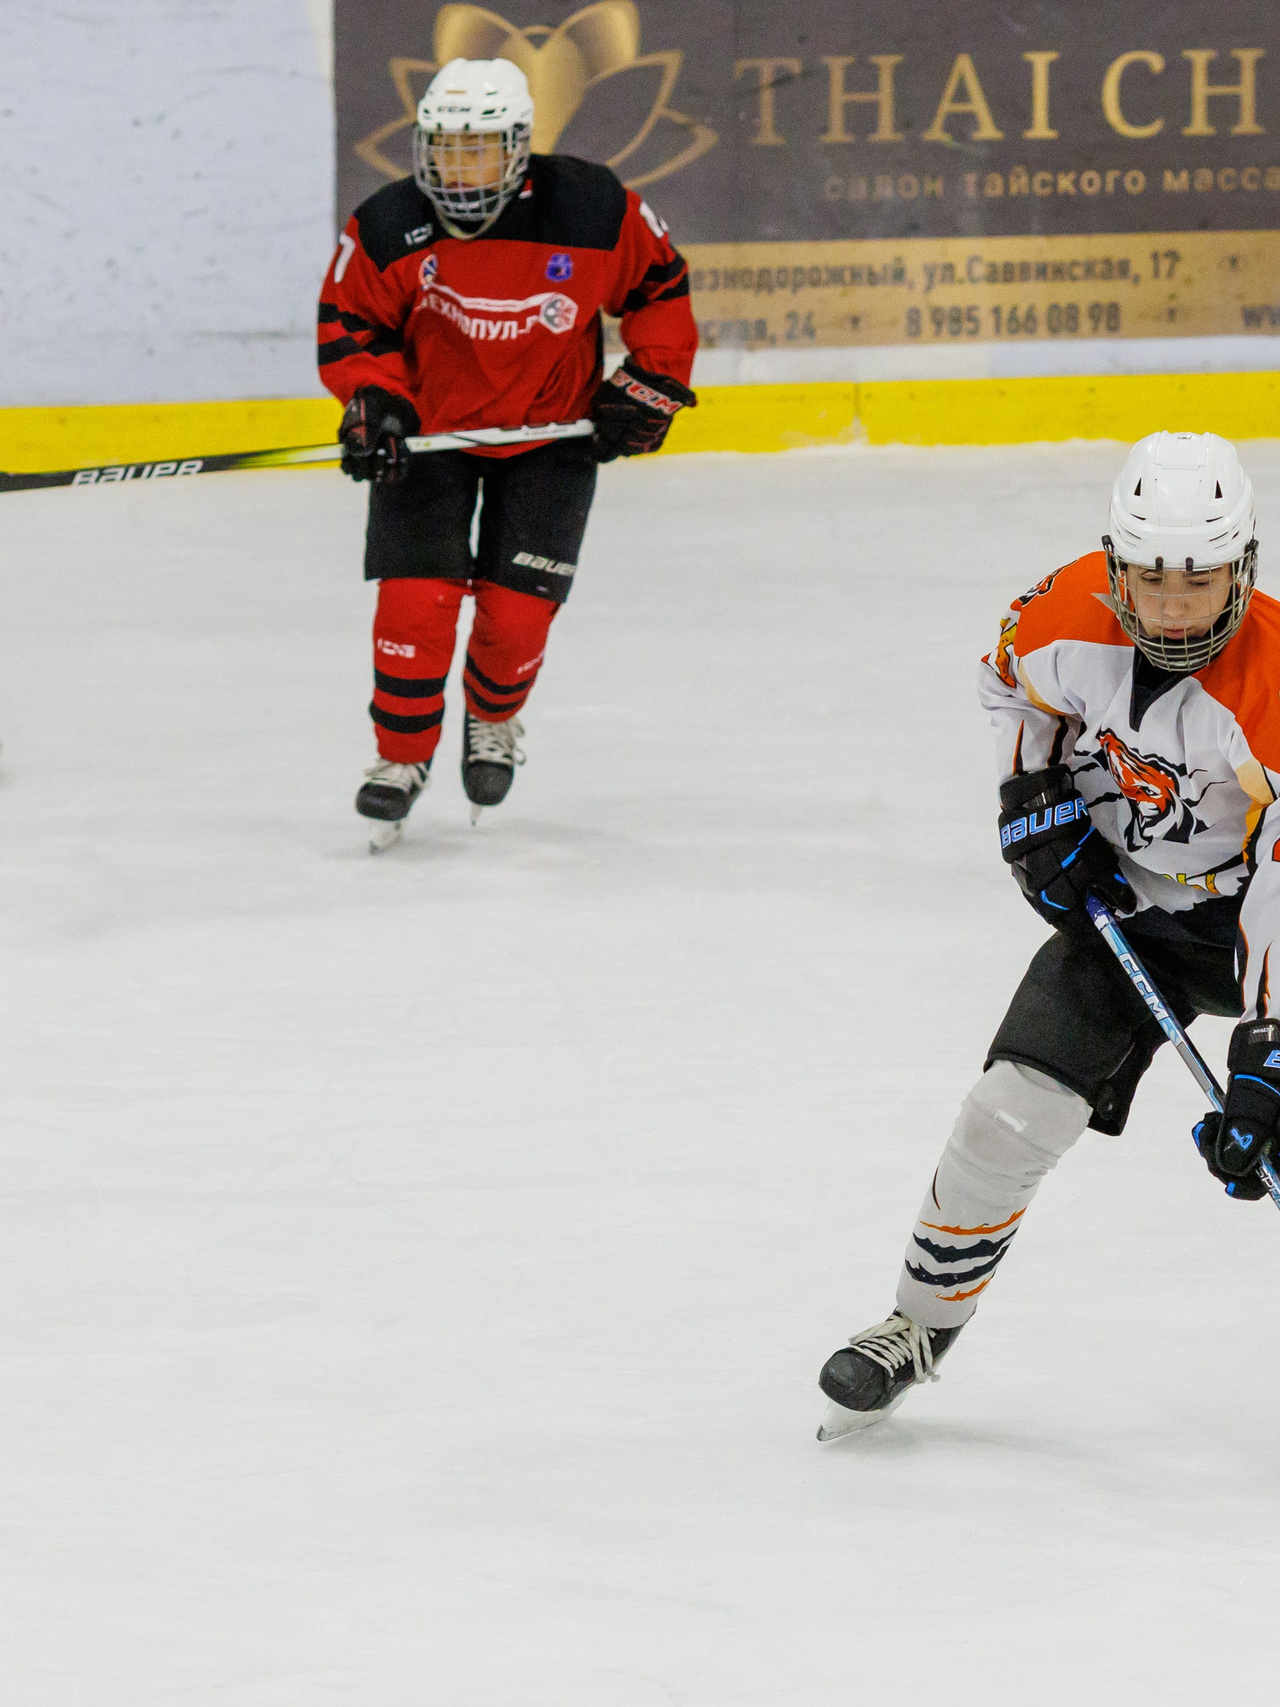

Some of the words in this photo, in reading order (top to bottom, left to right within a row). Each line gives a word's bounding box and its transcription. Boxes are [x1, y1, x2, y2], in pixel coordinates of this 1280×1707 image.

[735, 52, 1060, 146] THAI
[963, 164, 1147, 197] тайского
[691, 256, 916, 295] езнодорожный,
[1150, 249, 1181, 280] 17
[990, 303, 1038, 335] 166
[72, 460, 204, 486] BAUER
[511, 551, 576, 577] BAUE
[1000, 797, 1089, 849] BAUER
[1118, 953, 1170, 1022] CCM
